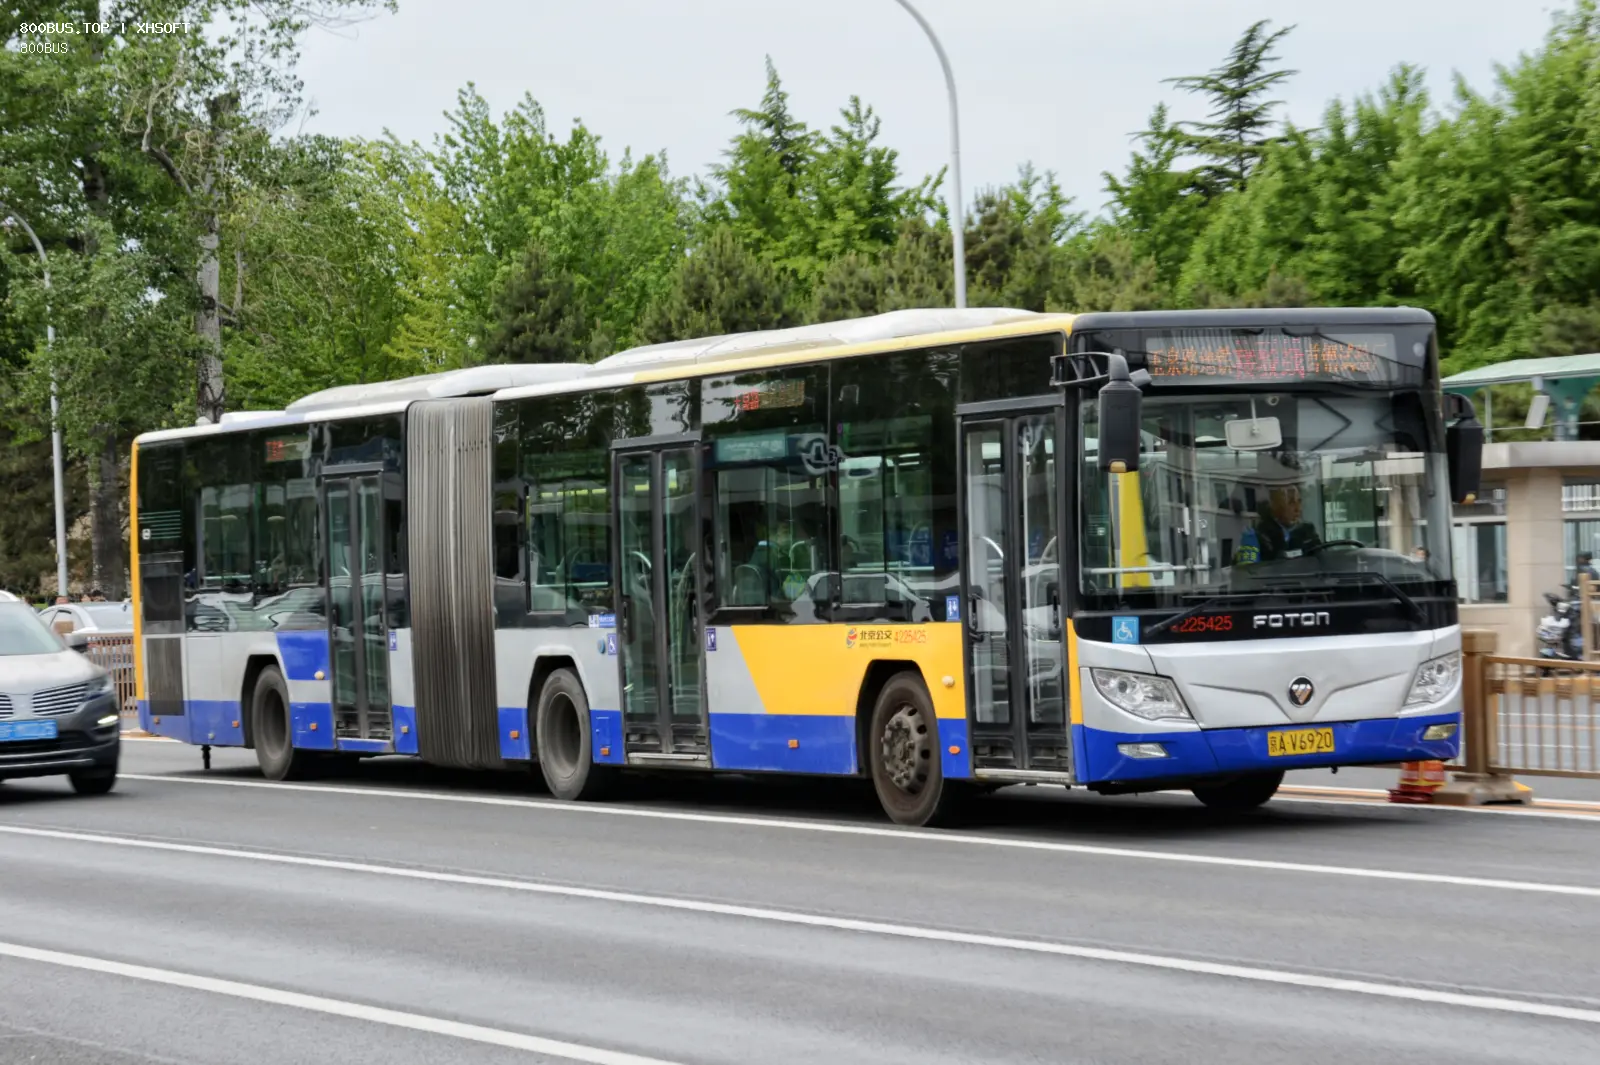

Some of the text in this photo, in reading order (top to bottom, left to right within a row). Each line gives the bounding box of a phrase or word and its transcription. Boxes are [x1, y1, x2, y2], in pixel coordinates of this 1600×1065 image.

[1253, 611, 1330, 629] FOTON
[860, 630, 892, 640] 北京公交
